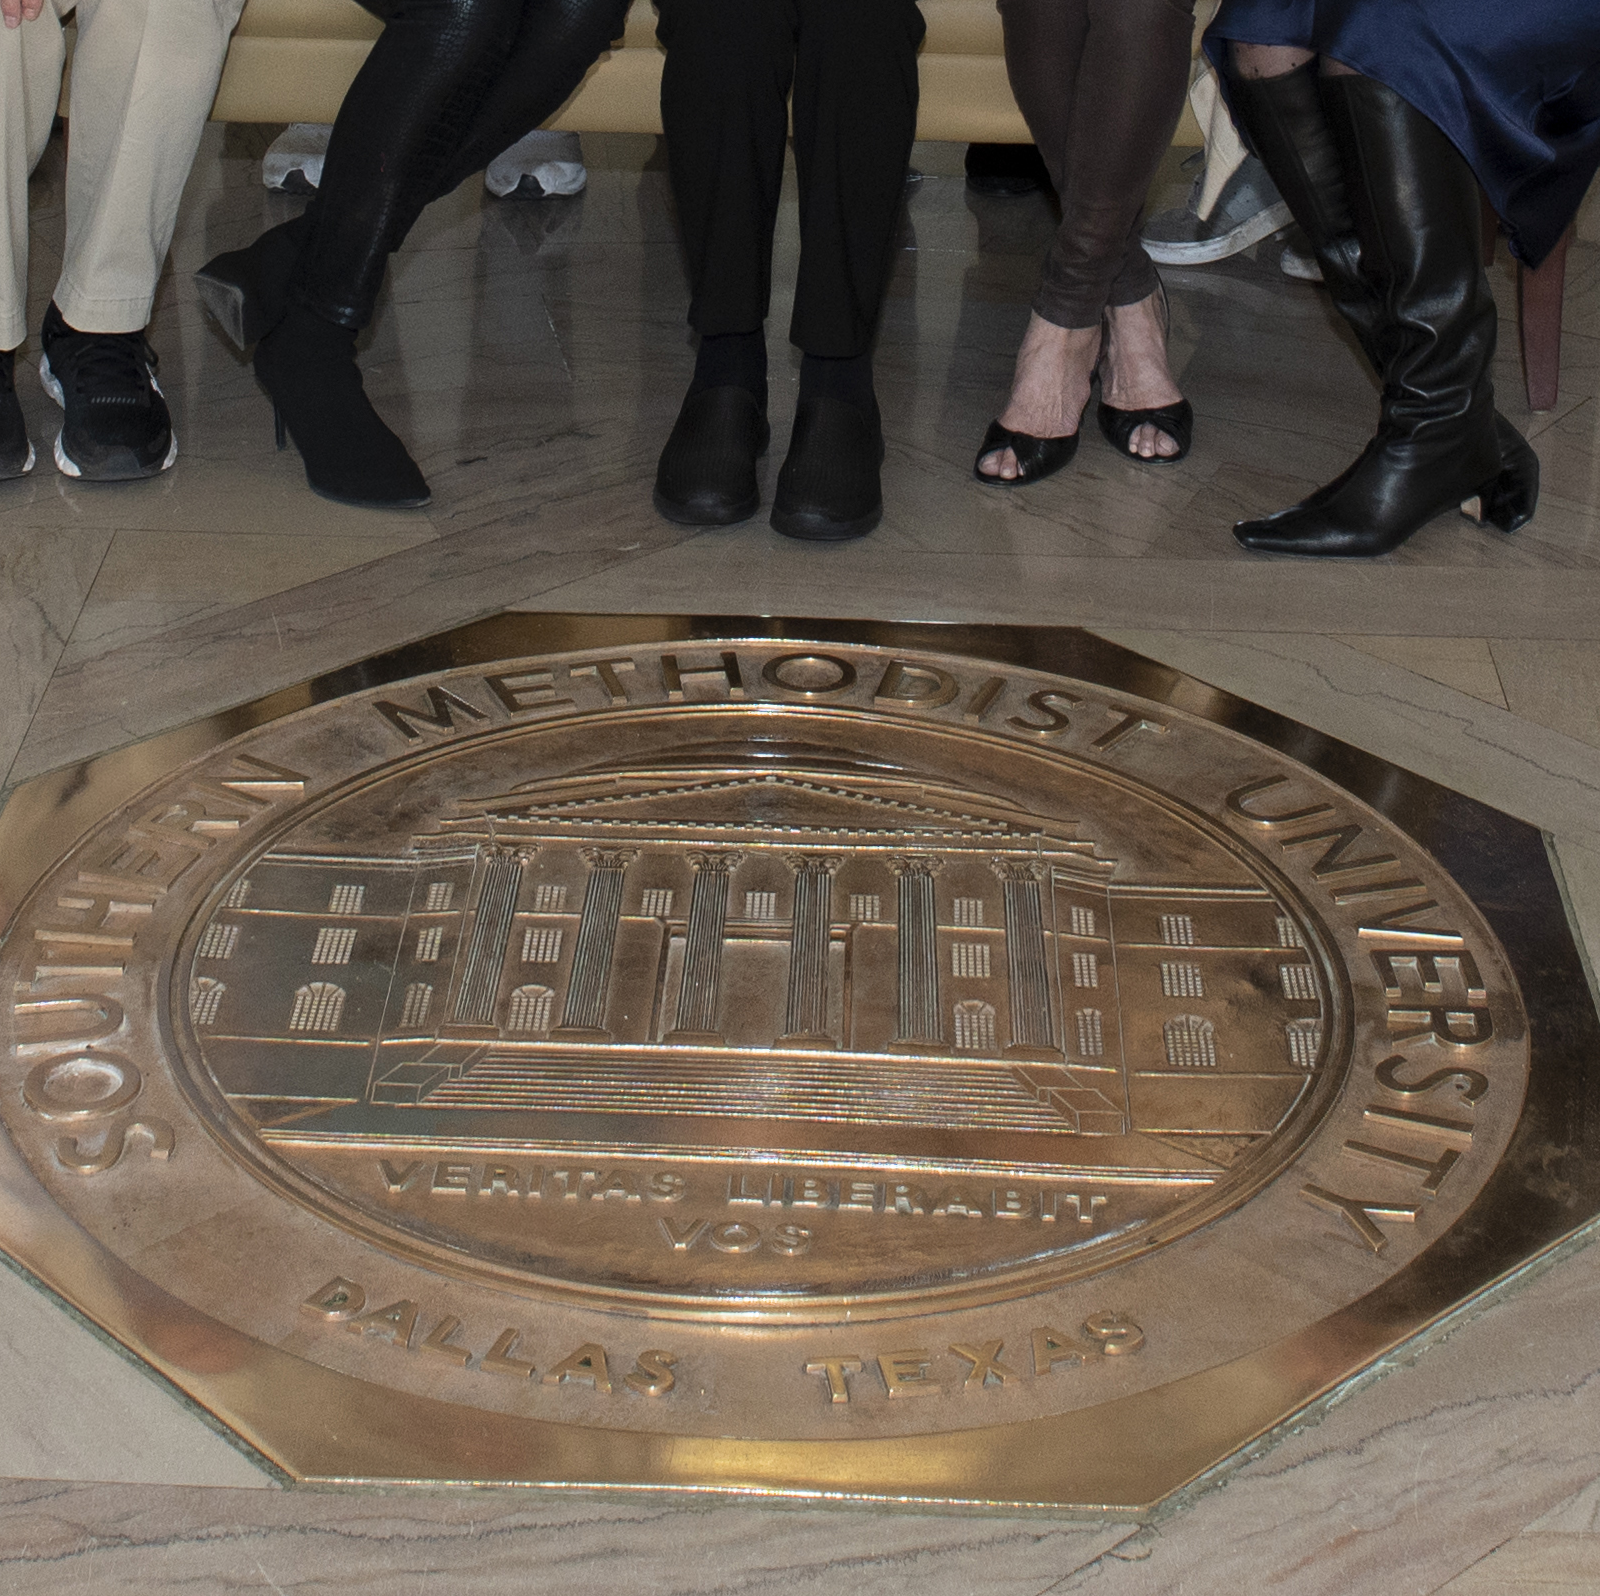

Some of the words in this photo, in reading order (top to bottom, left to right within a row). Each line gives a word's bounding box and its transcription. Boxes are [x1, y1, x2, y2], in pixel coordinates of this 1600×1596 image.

[14, 752, 309, 1176] SOUTHERN
[372, 651, 1171, 753] METHODIST
[1224, 773, 1495, 1253] UNIVERSITY
[375, 1158, 687, 1204] VERITAS
[726, 1171, 1107, 1225] LIBERABIT
[657, 1215, 812, 1257] VOS
[303, 1274, 680, 1398] DALLAS
[805, 1308, 1147, 1404] TEXAS
